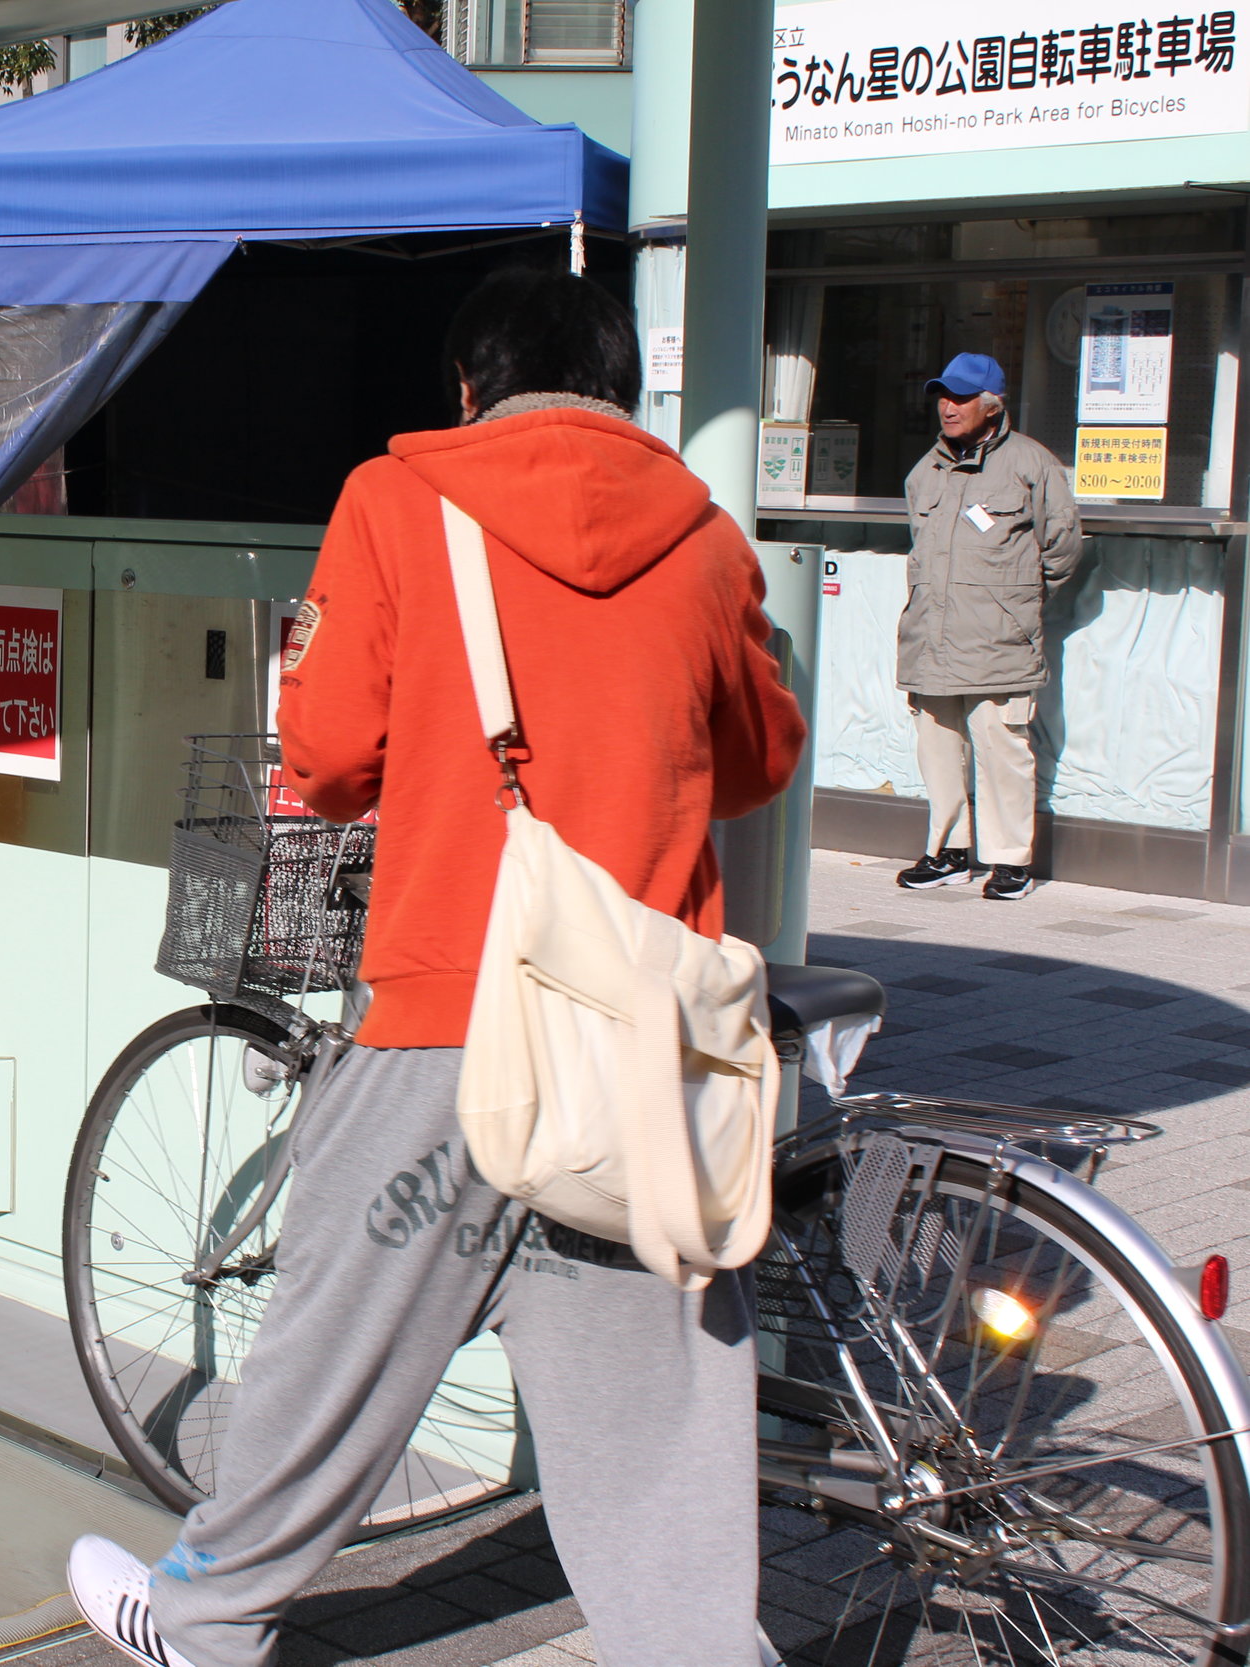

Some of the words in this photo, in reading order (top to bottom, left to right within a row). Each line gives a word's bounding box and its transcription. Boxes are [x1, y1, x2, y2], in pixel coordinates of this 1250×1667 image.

[772, 11, 1236, 110] うなん星の公園自転車駐車場
[785, 121, 838, 142] Minato
[844, 119, 893, 138] Konan
[902, 112, 977, 133] Hoshi-no
[983, 106, 1022, 127] Park
[1029, 103, 1070, 124] Area
[1077, 100, 1103, 120] for
[1111, 95, 1186, 118] Bicycles
[1081, 438, 1162, 449] 新規利用受付時間
